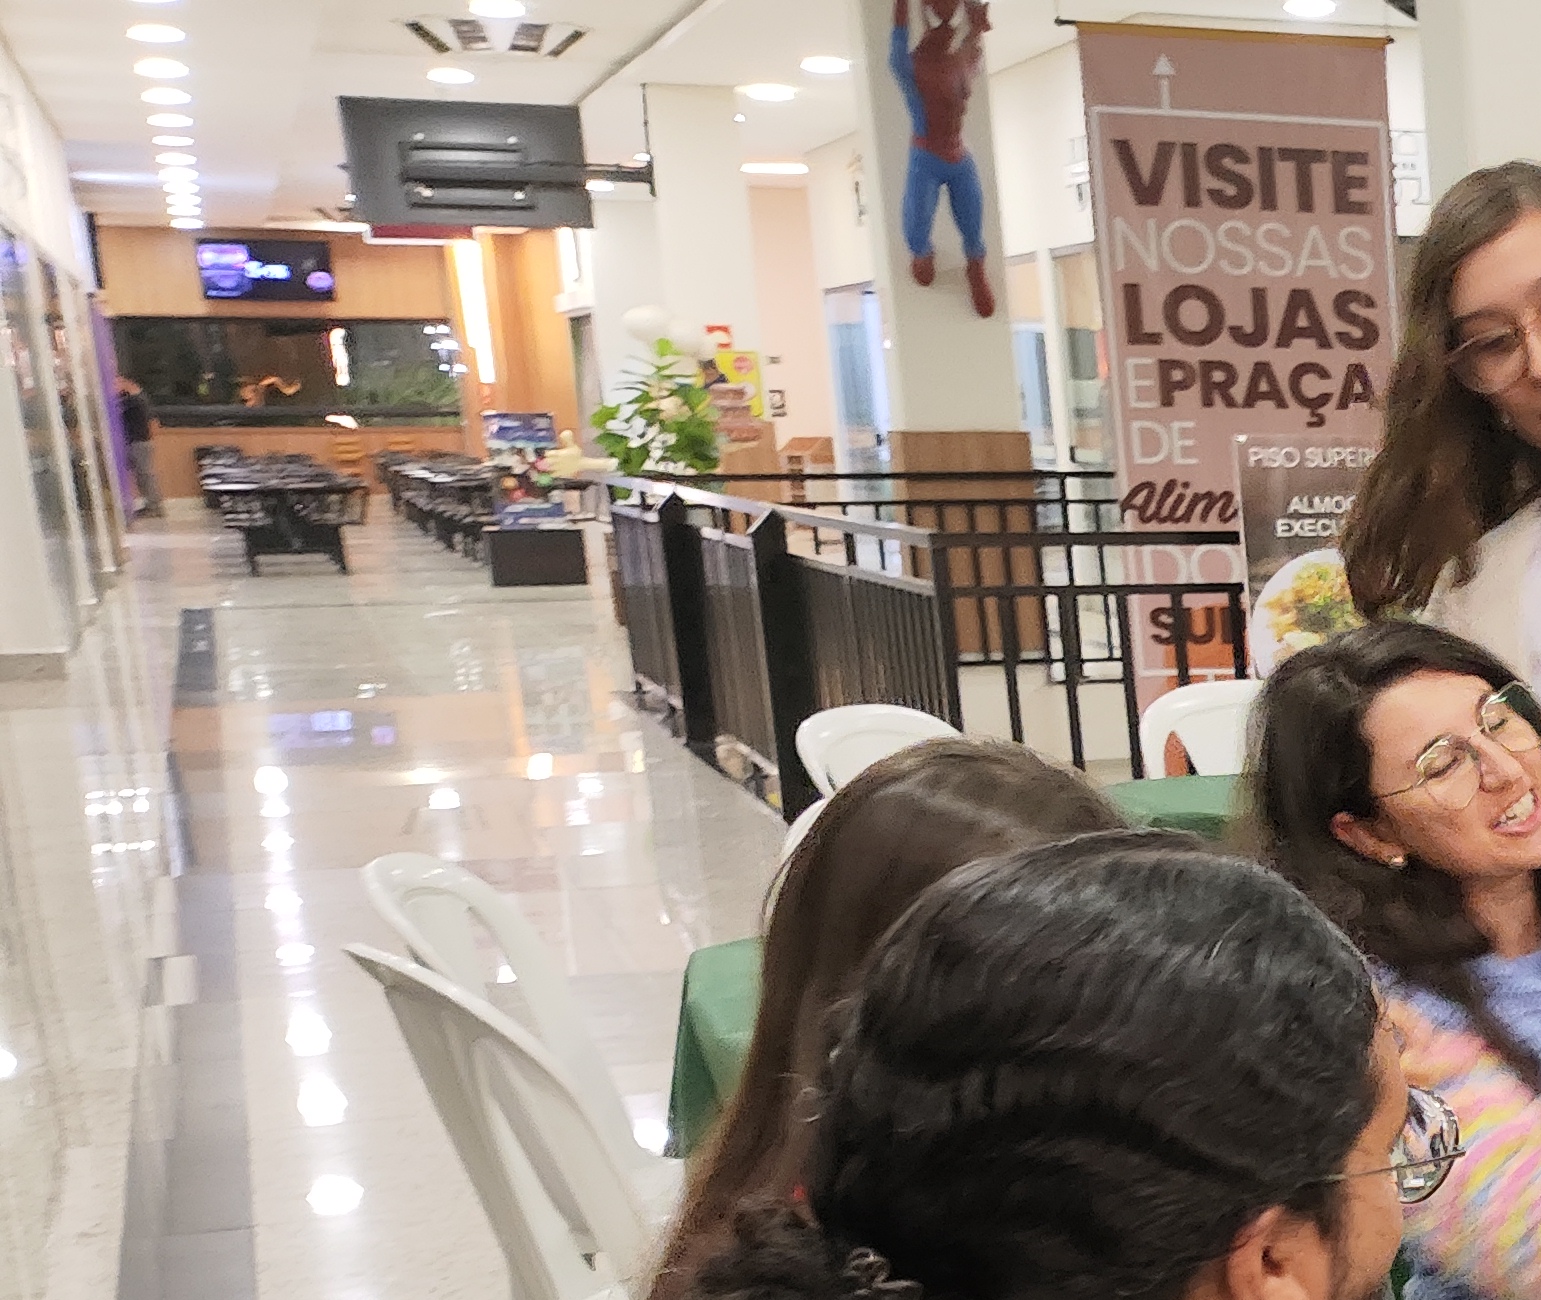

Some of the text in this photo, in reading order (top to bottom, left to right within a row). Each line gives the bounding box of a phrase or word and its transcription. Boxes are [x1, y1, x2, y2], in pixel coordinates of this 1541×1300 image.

[1110, 138, 1373, 215] VISITE
[1112, 216, 1375, 280] NOSSAS
[1122, 282, 1380, 351] LOJAS
[1158, 358, 1375, 428] PRAÇA
[1130, 420, 1200, 465] DE
[1249, 446, 1301, 468] PISO
